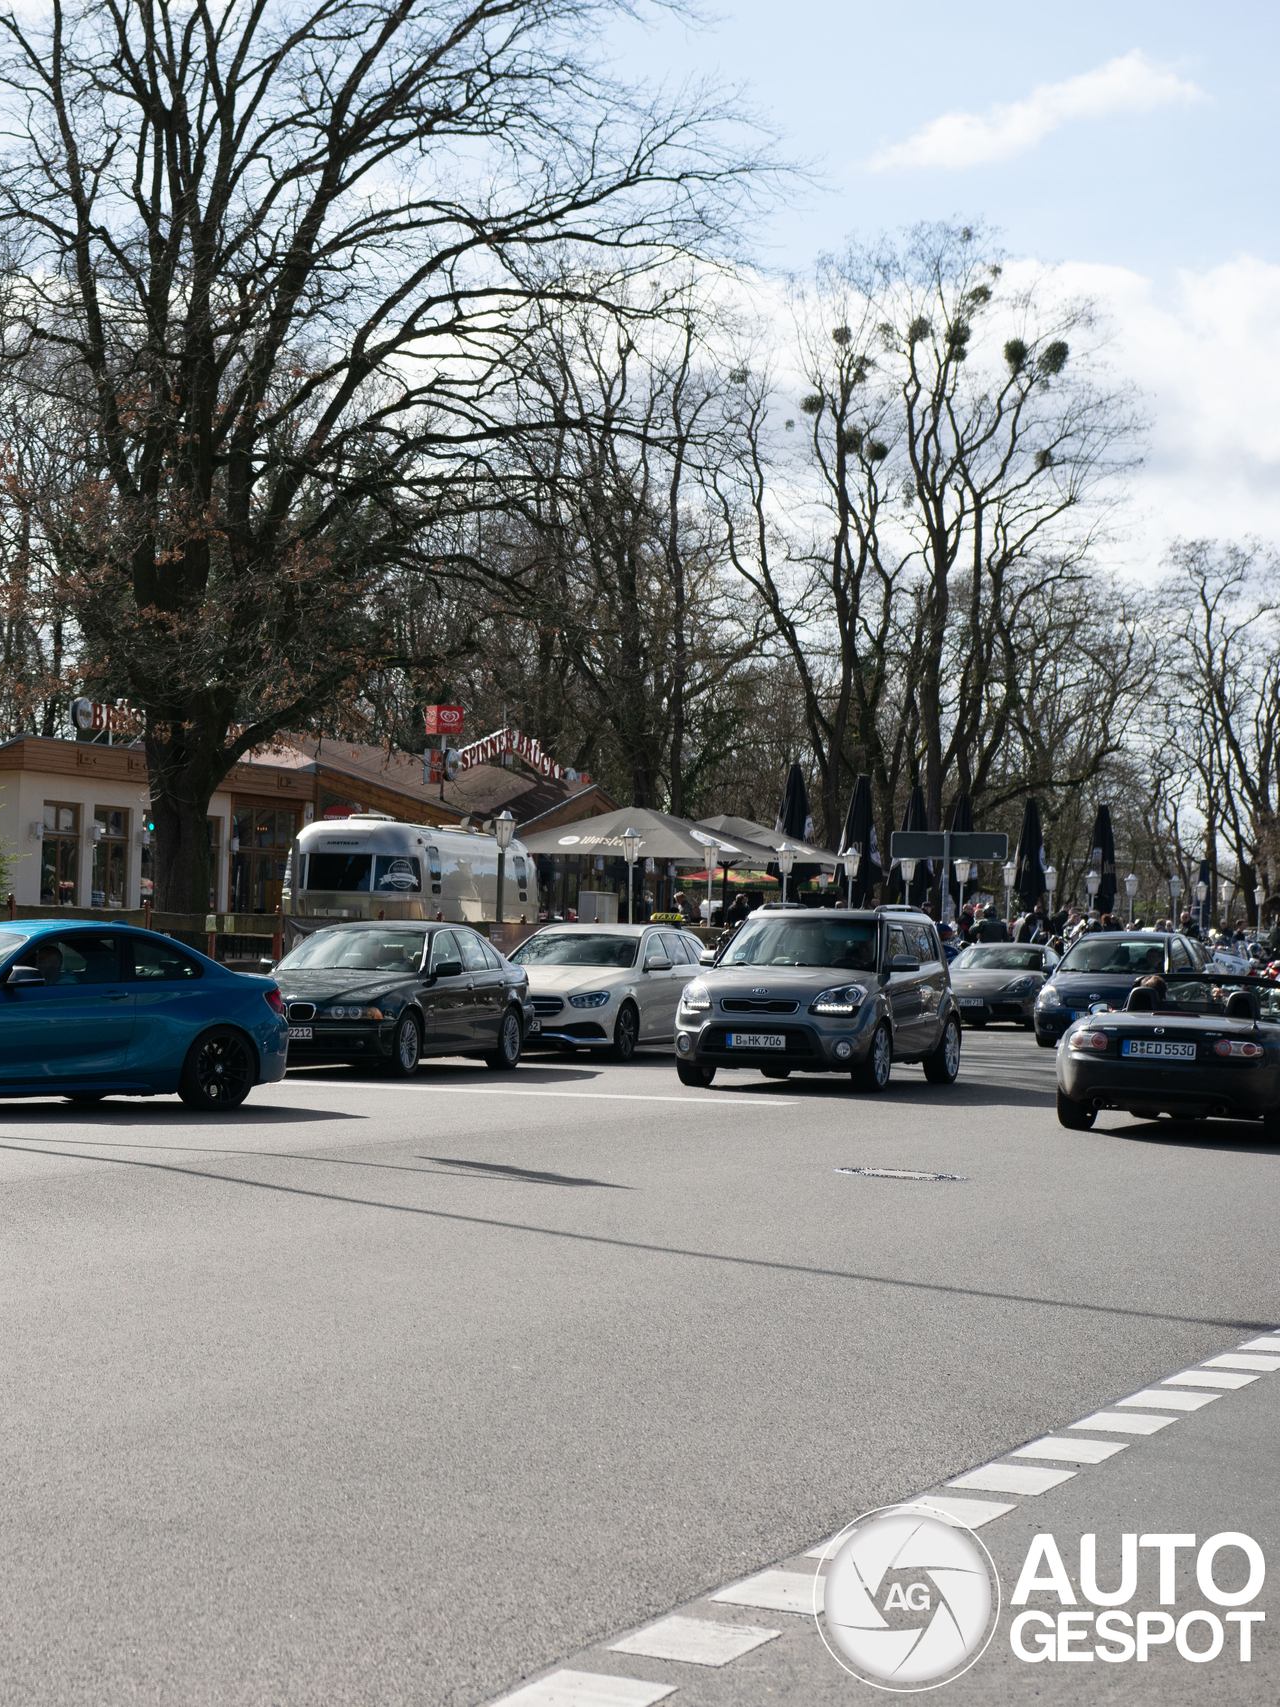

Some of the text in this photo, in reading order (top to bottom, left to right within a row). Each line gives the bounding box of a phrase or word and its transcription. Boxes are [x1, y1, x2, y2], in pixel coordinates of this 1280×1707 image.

[289, 1028, 311, 1038] 2212
[736, 1036, 781, 1046] B HK 706
[1130, 1042, 1194, 1056] B ED 5530
